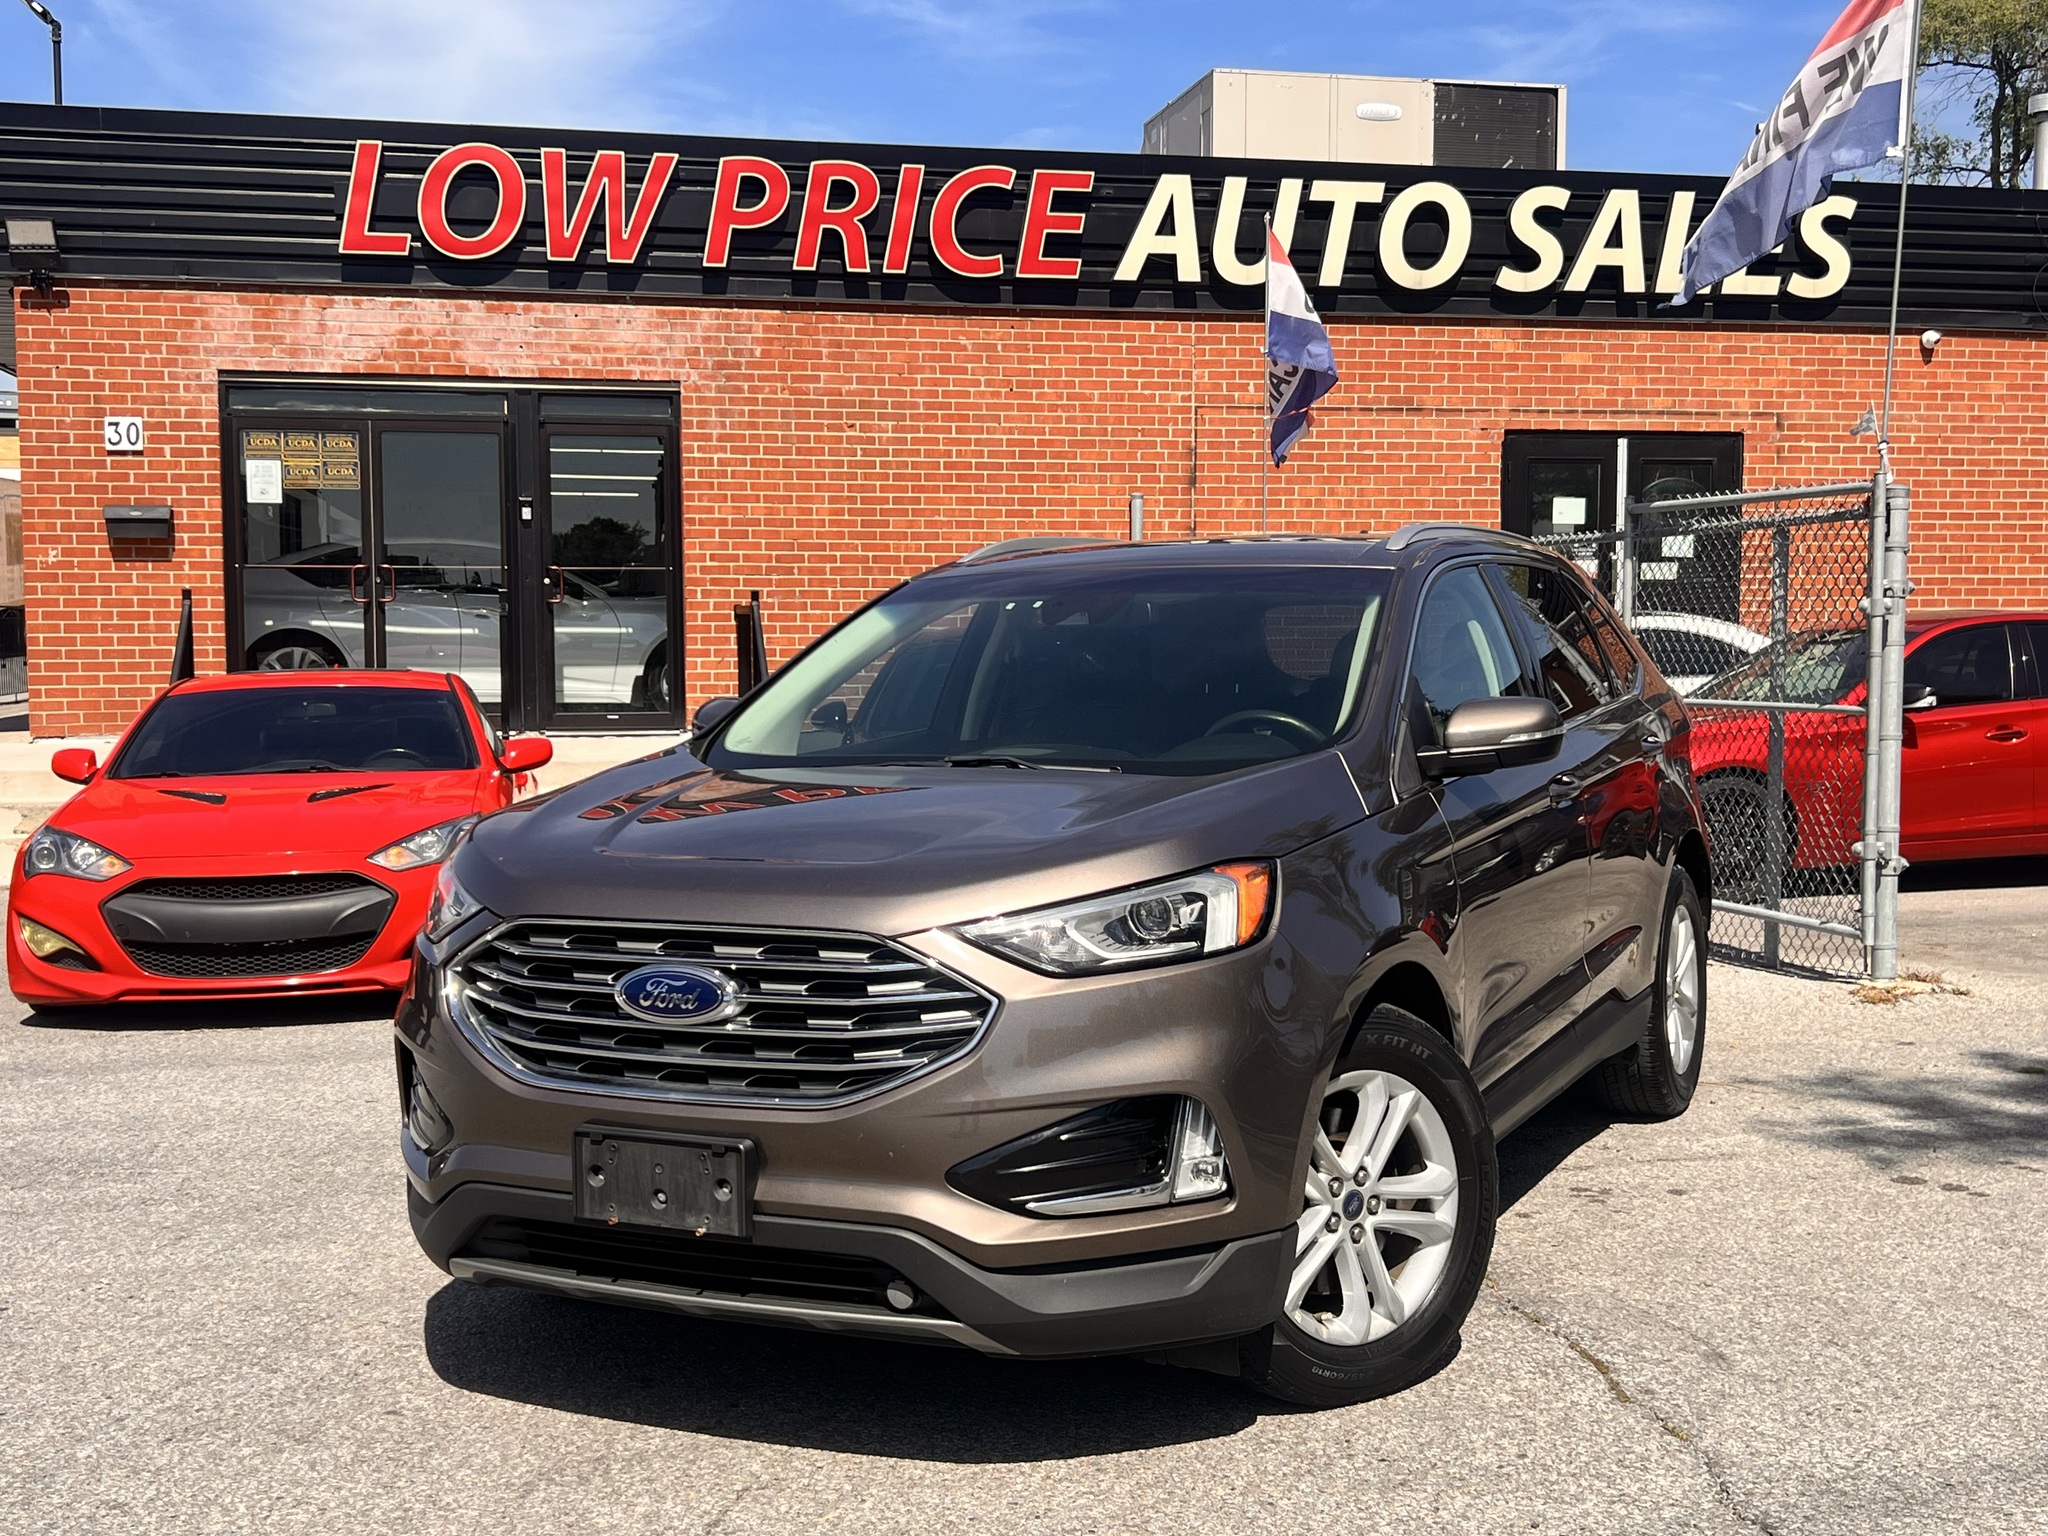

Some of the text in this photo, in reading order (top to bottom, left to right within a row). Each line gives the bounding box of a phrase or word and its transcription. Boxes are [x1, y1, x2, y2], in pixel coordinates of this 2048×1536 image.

[338, 139, 679, 261] LOW
[702, 155, 1095, 279] PRICE
[1112, 173, 1473, 290] AUTO
[107, 421, 140, 446] 30
[250, 438, 277, 446] UCDA
[288, 440, 315, 448] UCDA
[326, 440, 353, 449] UCDA
[289, 468, 315, 476] UCDA
[327, 468, 354, 476] UCDA
[638, 977, 701, 1010] Ford
[1382, 1034, 1409, 1049] FIT
[1410, 1042, 1432, 1060] HT
